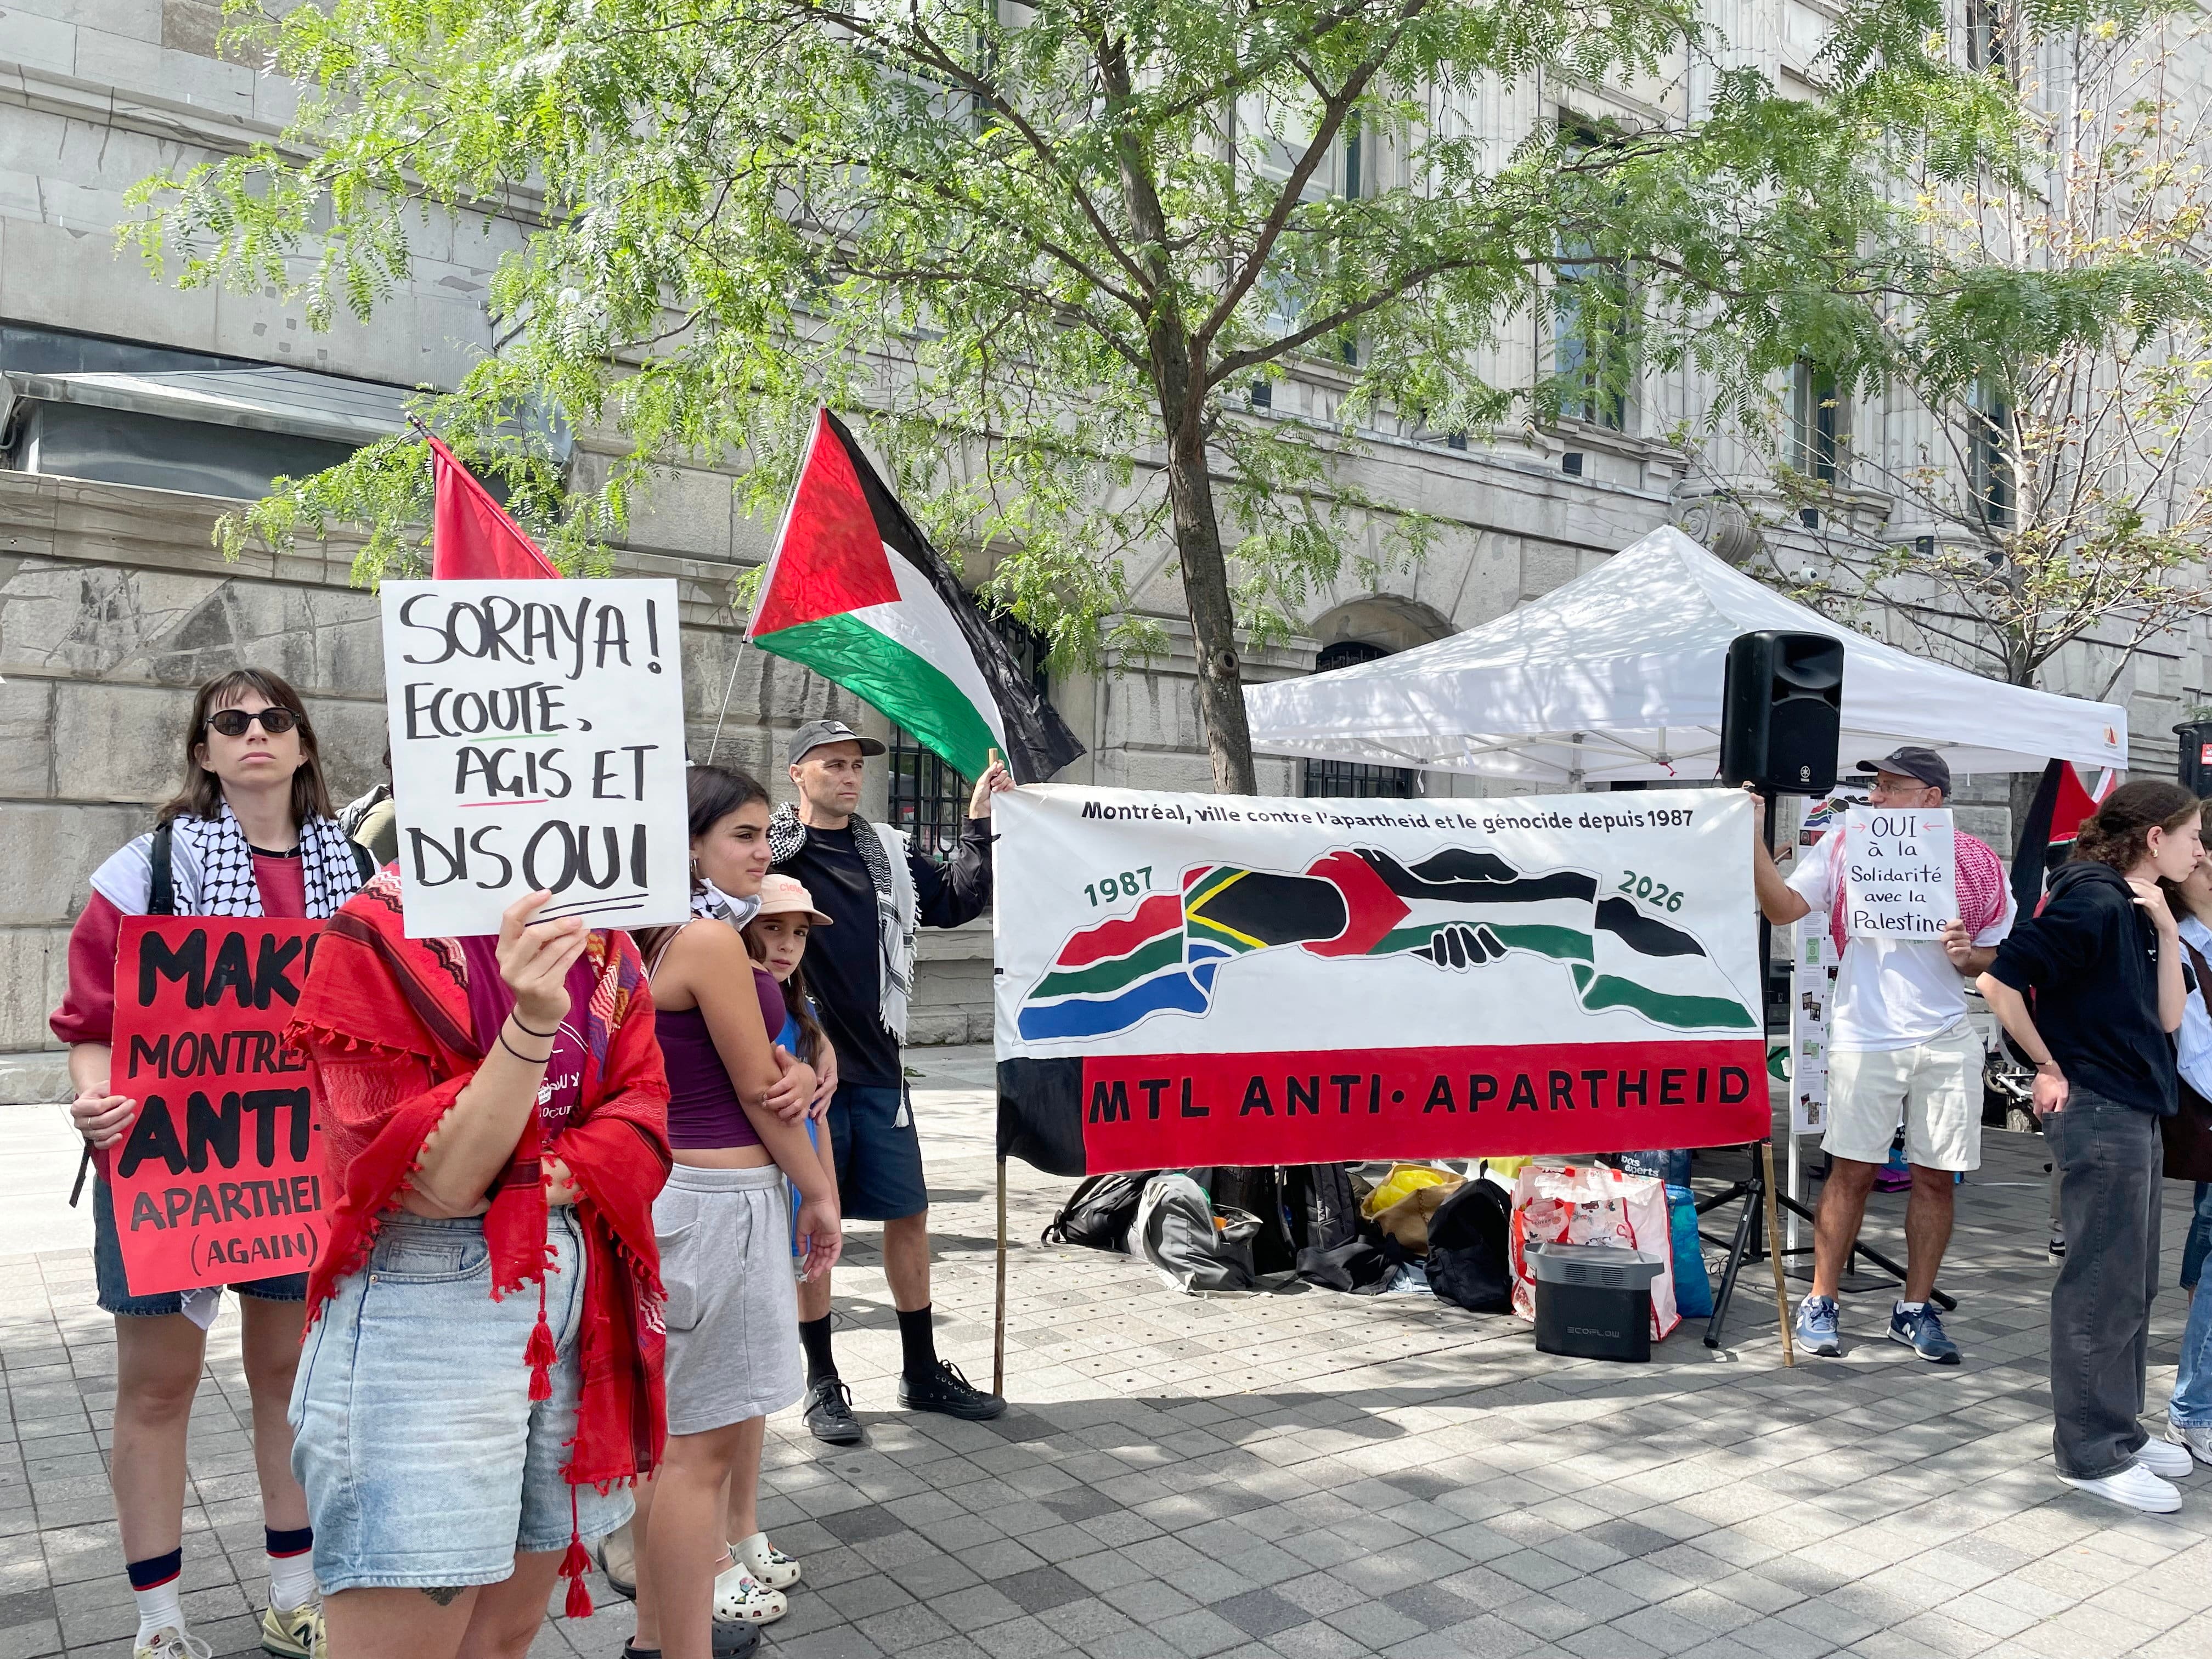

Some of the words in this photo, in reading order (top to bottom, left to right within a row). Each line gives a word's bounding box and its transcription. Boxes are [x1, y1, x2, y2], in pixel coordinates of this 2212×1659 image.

[399, 594, 662, 680] SORAYA!
[404, 681, 592, 739] ECOUTE,
[455, 746, 572, 799] AGIS
[592, 744, 659, 801] ET
[1081, 801, 1191, 824] Montréal,
[1195, 805, 1240, 822] ville
[1246, 810, 1312, 823] contre
[1316, 811, 1431, 829] l'apartheid
[1435, 814, 1454, 828] et
[1457, 814, 1477, 829] le
[1482, 811, 1573, 834] génocide
[1578, 810, 1645, 833] depuis
[1647, 809, 1694, 827] 1987
[1871, 815, 1917, 837] OUI
[405, 826, 514, 889] DIS
[522, 820, 648, 895] OUI
[1867, 841, 1884, 857] à
[1898, 840, 1918, 856] la
[1083, 866, 1153, 907] 1987
[1617, 870, 1684, 913] 2026
[1851, 864, 1942, 883] Solidarité
[1864, 892, 1902, 903] avec
[1910, 890, 1927, 902] la
[1854, 911, 1947, 932] Palestine
[128, 1030, 306, 1079] MONTRE
[1088, 1076, 1210, 1124] MTL
[1423, 1066, 1750, 1114] APARTHEID
[131, 1175, 321, 1232] APARTHEI
[191, 1222, 318, 1277] (AGAIN)
[1566, 1327, 1620, 1338] ECOFLOW
